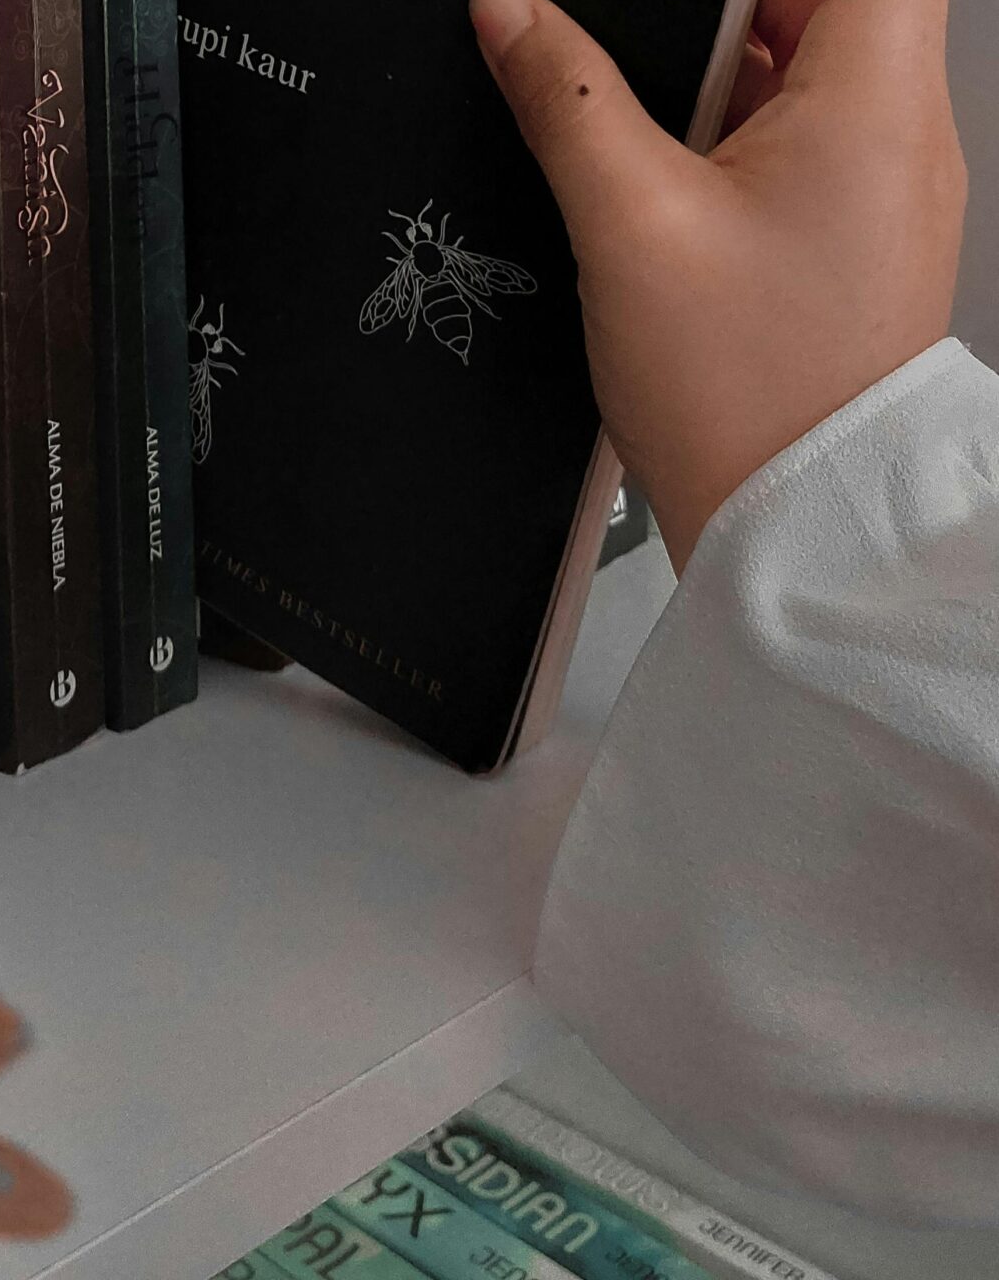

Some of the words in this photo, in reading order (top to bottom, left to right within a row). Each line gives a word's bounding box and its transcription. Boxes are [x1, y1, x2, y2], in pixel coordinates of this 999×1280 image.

[235, 32, 317, 95] kaur
[46, 418, 64, 482] ALMA
[145, 425, 160, 485] ALMA
[48, 484, 65, 512] DE
[147, 486, 161, 514] DE
[49, 516, 68, 590] NIEBLA
[148, 518, 163, 563] LUZ
[199, 538, 270, 593] TIMES
[278, 589, 443, 702] BESTSELLER
[419, 1126, 599, 1254] SIDIAN
